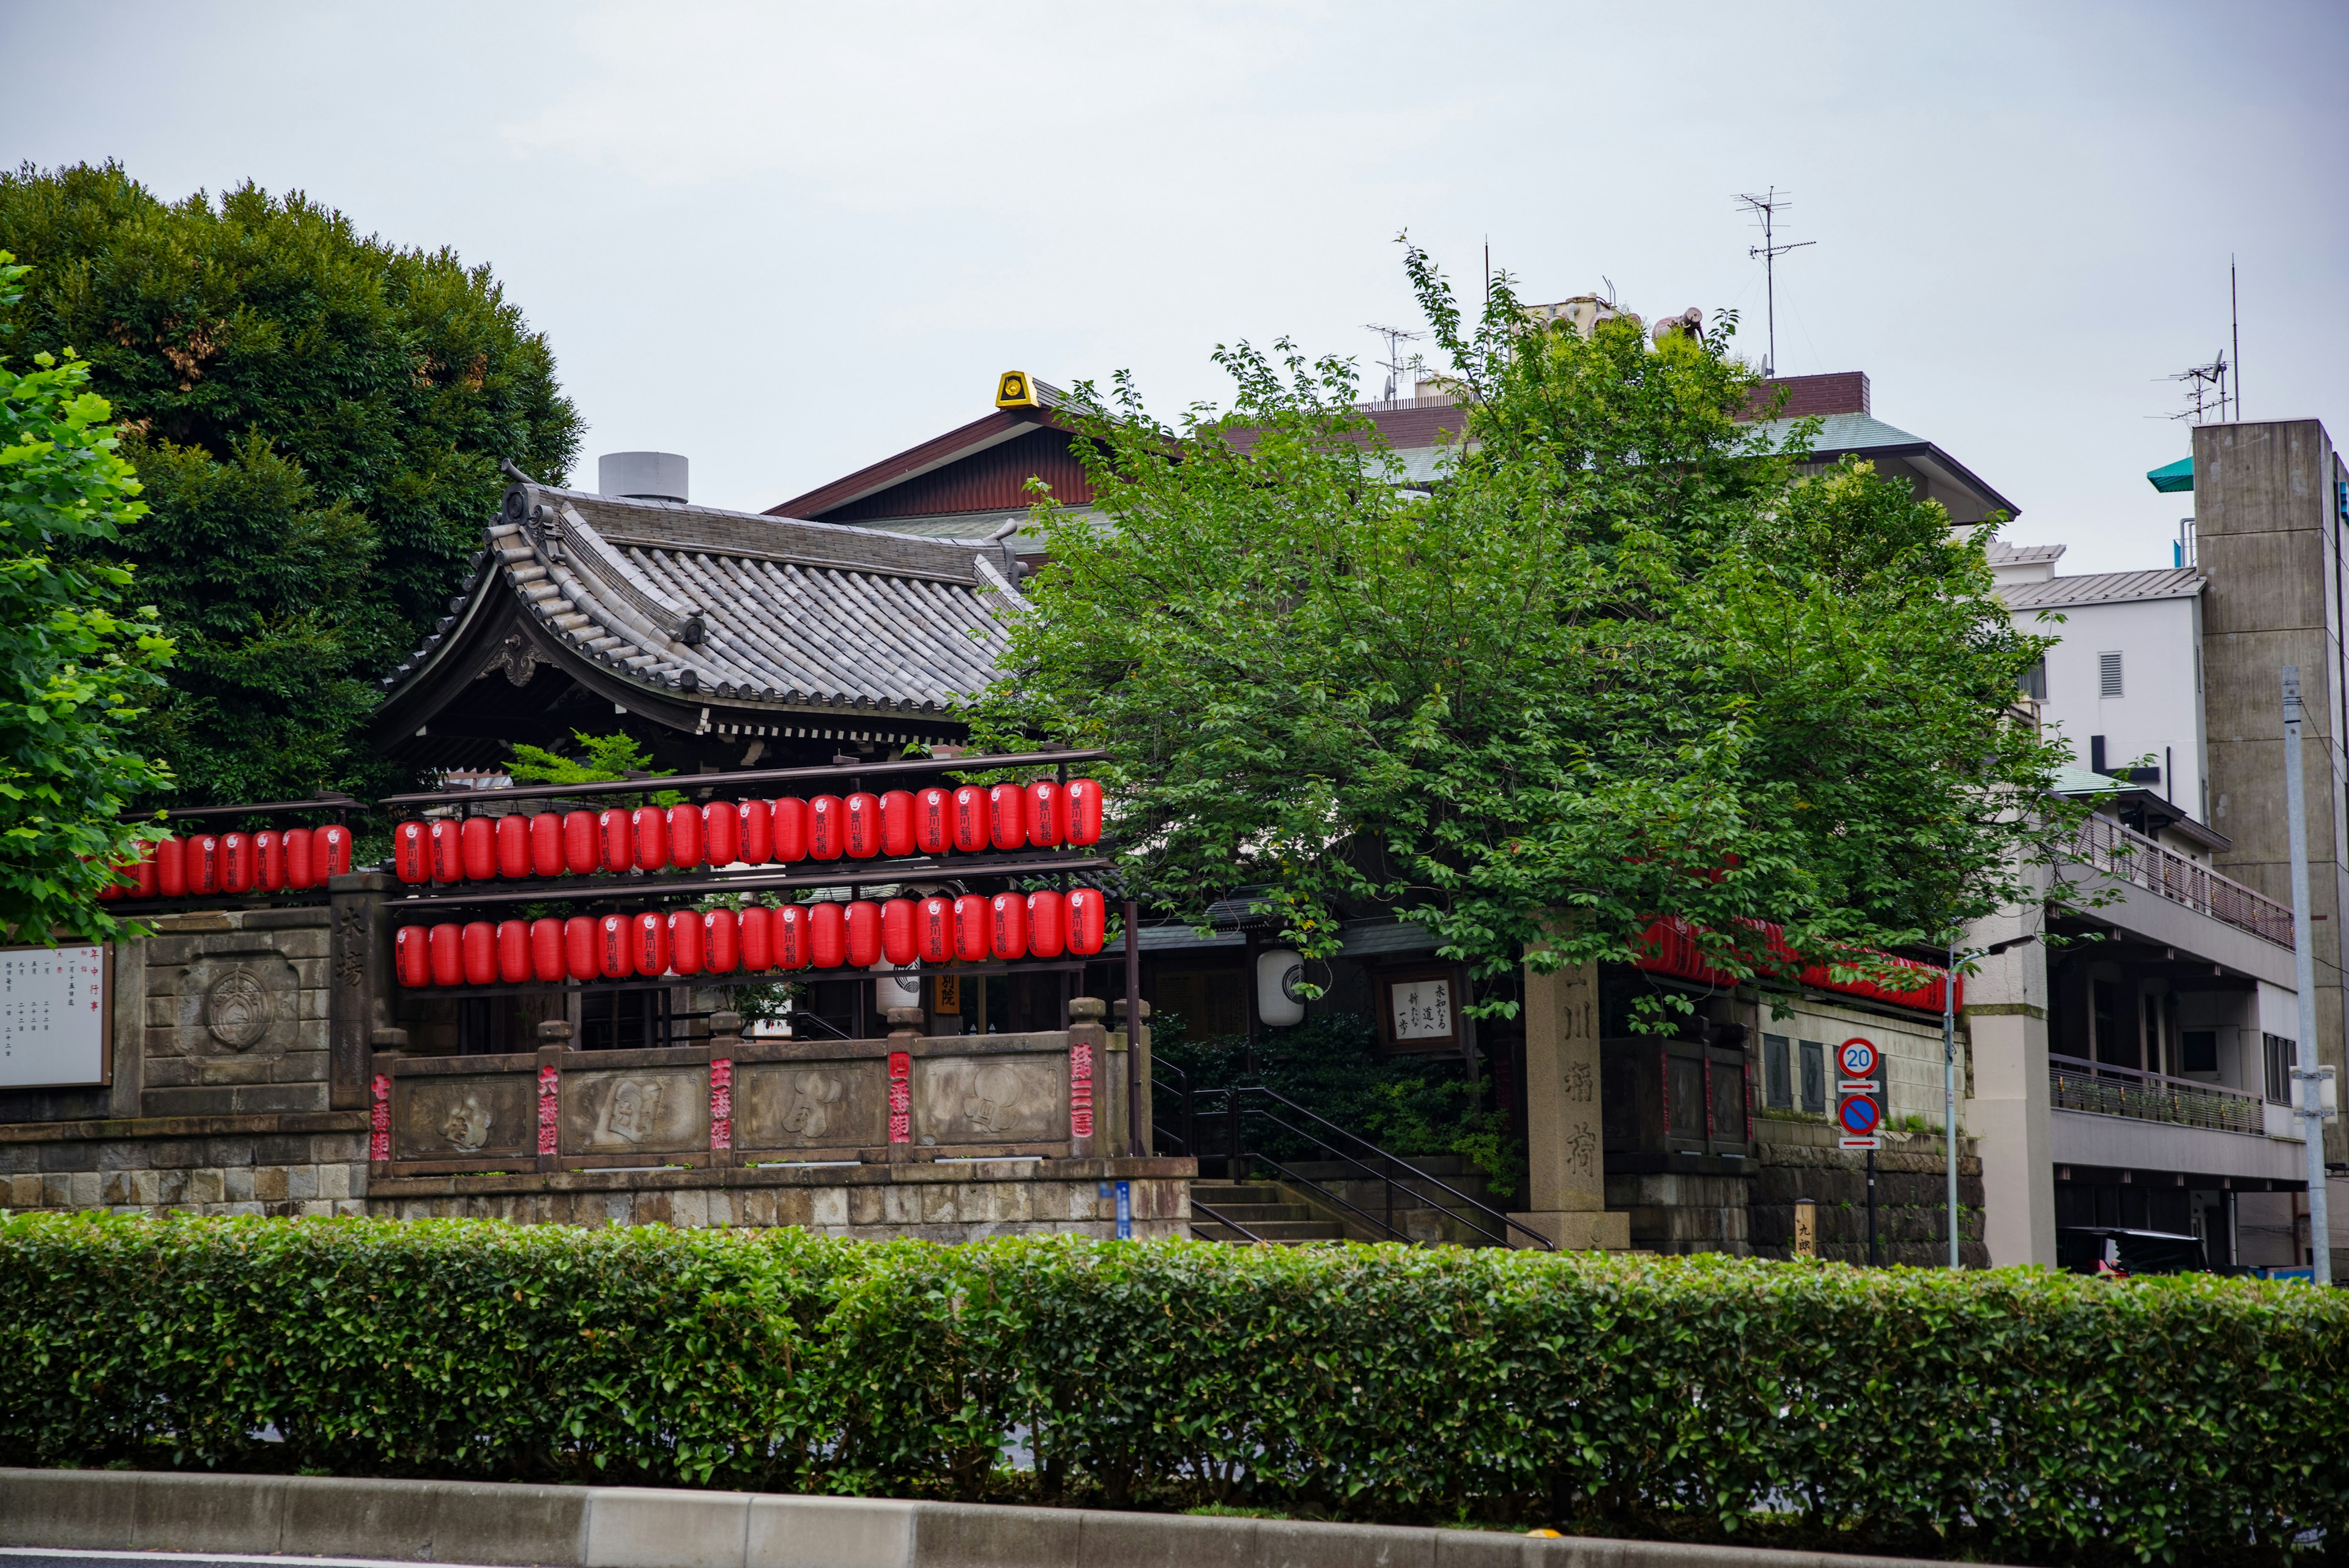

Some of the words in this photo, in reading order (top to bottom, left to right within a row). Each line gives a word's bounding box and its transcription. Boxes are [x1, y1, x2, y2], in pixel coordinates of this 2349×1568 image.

[816, 814, 826, 853] 豊川稲荷
[851, 811, 863, 852] 豊川稲荷
[929, 806, 940, 847] 豊川稲荷
[960, 806, 971, 845] 豊川稲荷
[992, 802, 1002, 842] 豊川稲荷
[1039, 800, 1051, 841] 豊川稲荷
[1071, 798, 1082, 839] 豊川稲荷
[407, 839, 417, 877] 豊川稲荷
[433, 838, 445, 877] 豊川稲荷
[740, 819, 750, 858] 豊川稲荷
[204, 852, 214, 890] 豊川稲荷
[226, 849, 237, 886] 豊川稲荷
[258, 849, 267, 886] 豊川稲荷
[705, 928, 715, 968] 豊川稲荷
[785, 924, 795, 963] 豊川稲荷
[929, 916, 941, 956] 豊川稲荷
[956, 915, 966, 954] 豊川稲荷
[995, 912, 1006, 953] 豊川稲荷
[1028, 910, 1037, 951] 豊川稲荷
[1072, 908, 1083, 949] 豊川稲荷
[18, 962, 24, 975] 九月
[32, 962, 37, 975] 五月
[44, 962, 50, 974] 一月
[58, 951, 62, 974] 大祭
[607, 932, 618, 972] 豊川稲荷
[645, 930, 656, 969] 豊川稲荷
[669, 929, 678, 969] 豊川稲荷
[91, 949, 99, 1012] 年中行事
[1398, 1012, 1408, 1035] 一歩
[1408, 992, 1419, 1027] 新たな
[1423, 1006, 1434, 1030] 道へ
[1435, 984, 1446, 1029] 未知なる
[1847, 1049, 1869, 1066] 20
[538, 1065, 558, 1155] 六番組
[710, 1058, 732, 1149] 五番組
[889, 1051, 910, 1143] 四番組
[371, 1073, 391, 1161] 七番組
